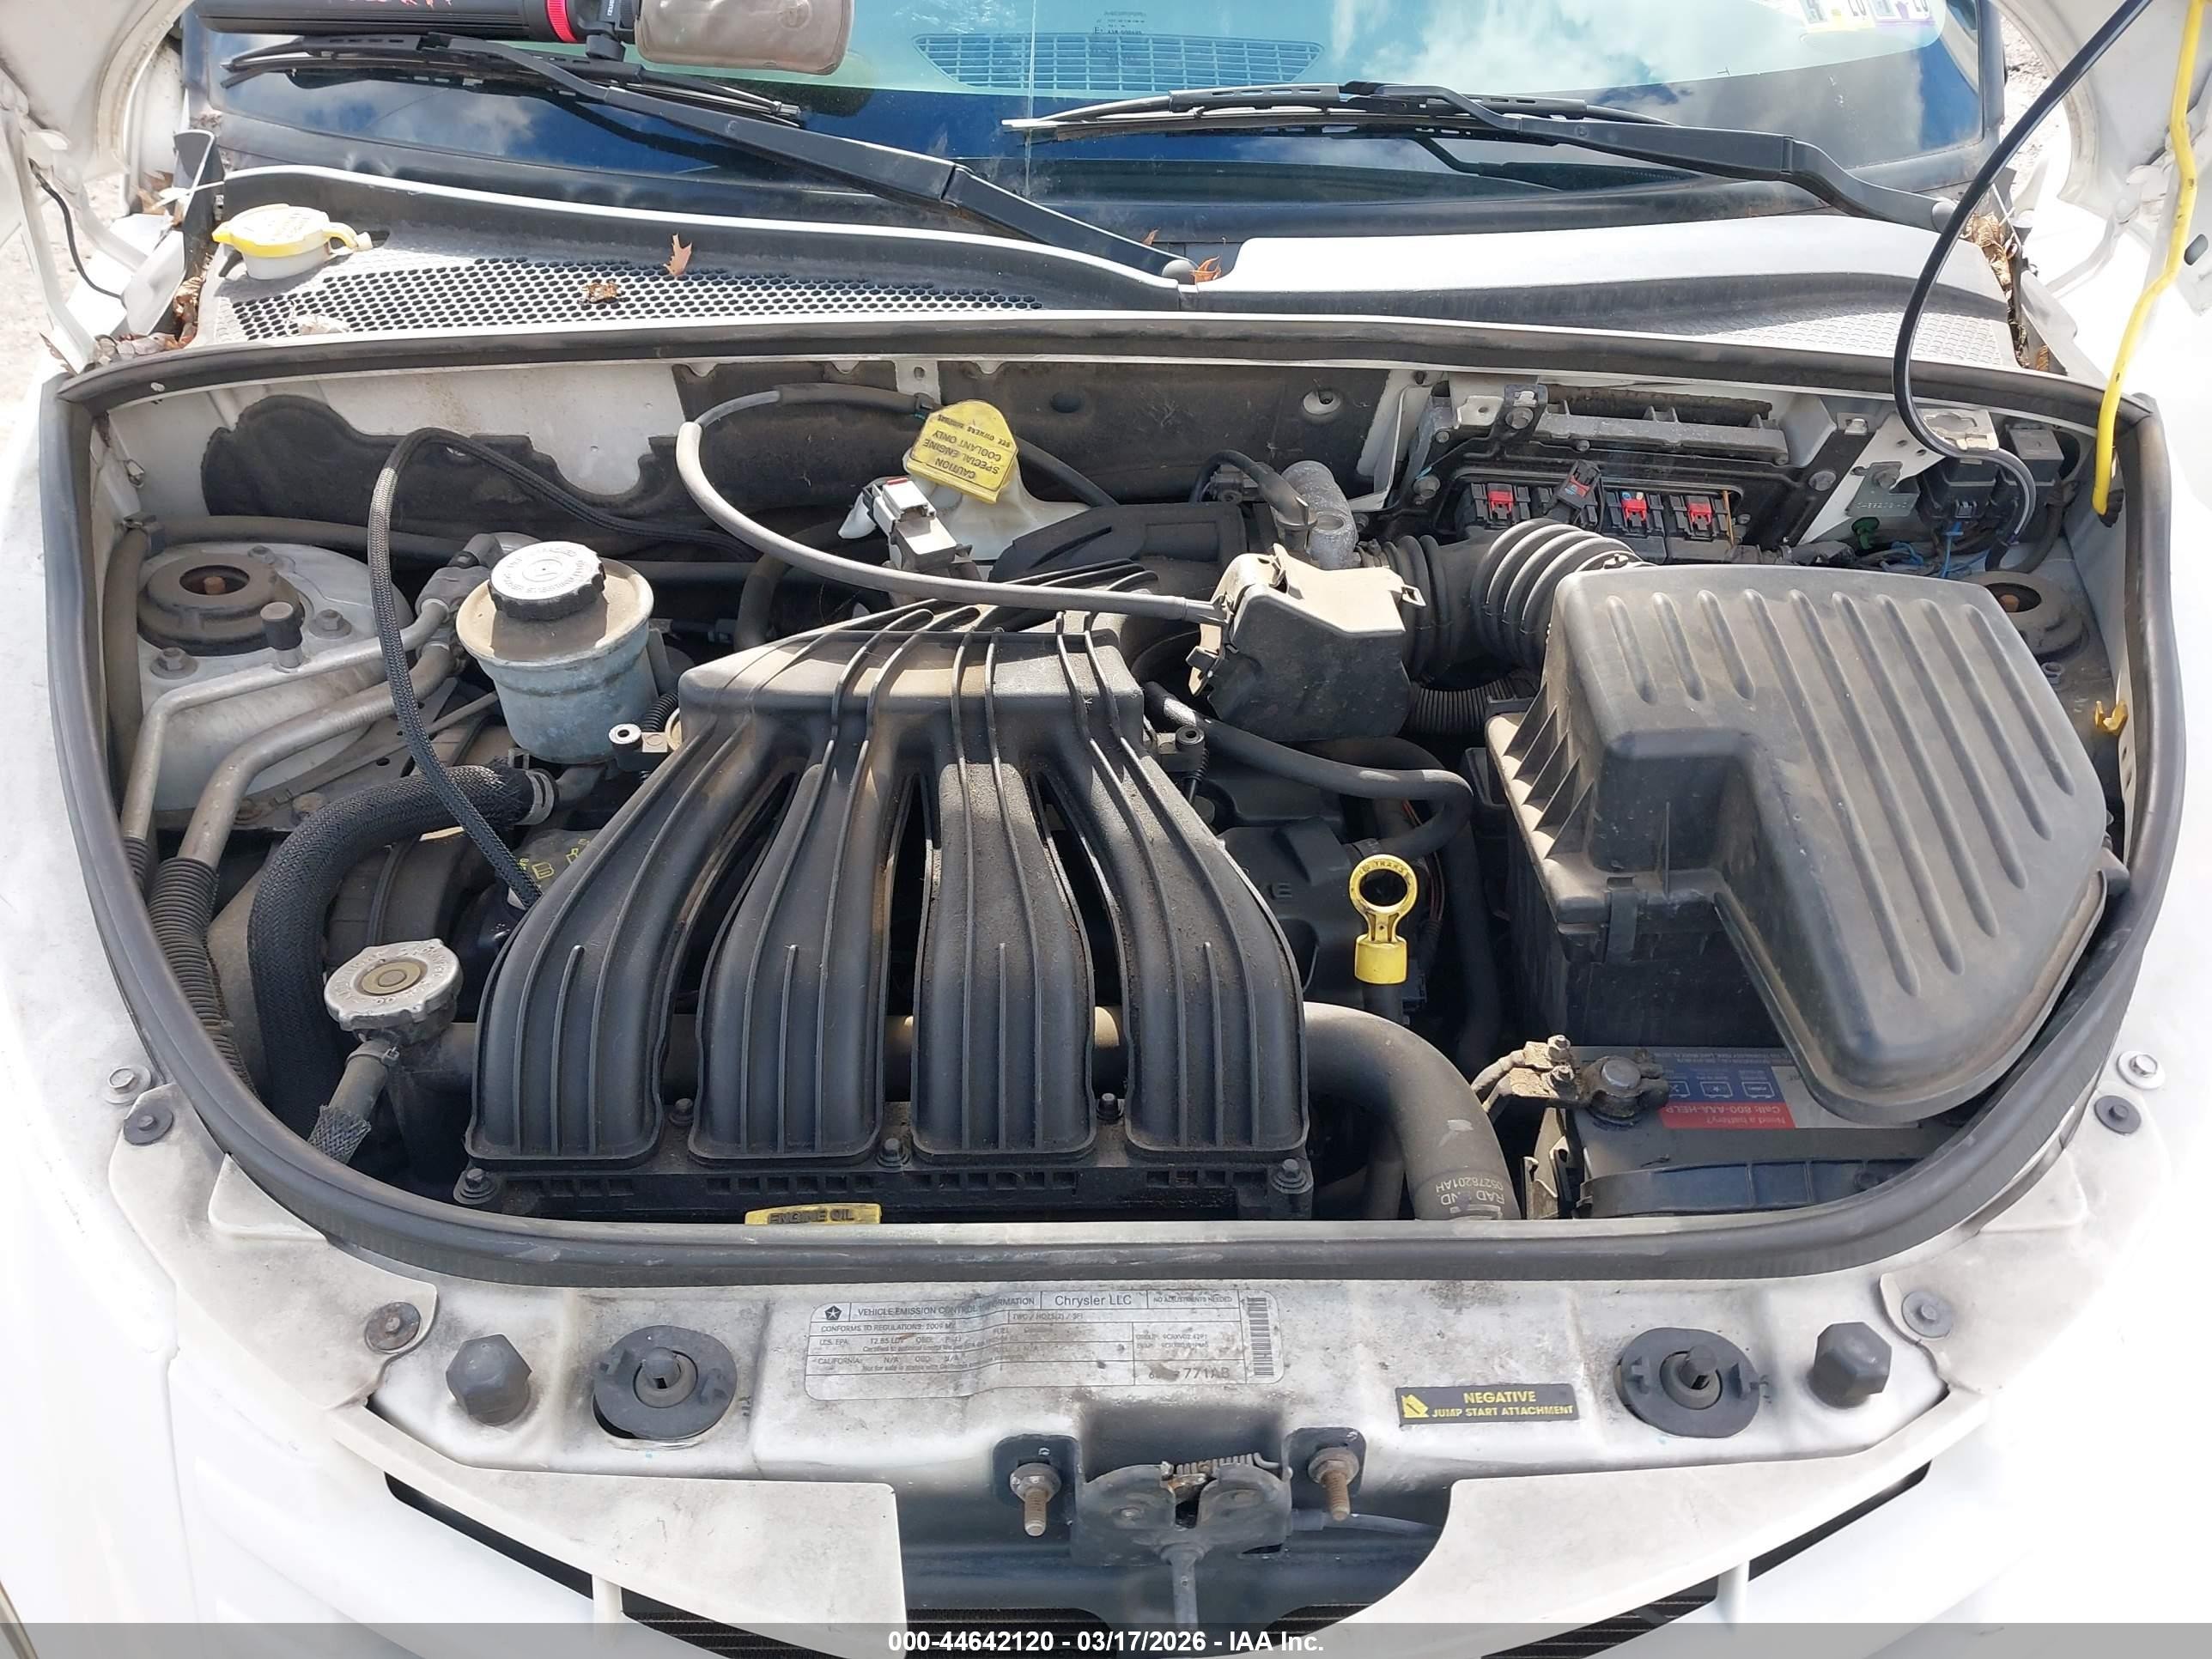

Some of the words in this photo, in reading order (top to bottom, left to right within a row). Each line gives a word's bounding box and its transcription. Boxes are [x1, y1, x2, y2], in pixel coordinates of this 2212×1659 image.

[933, 429, 957, 444] ONLY
[922, 438, 961, 458] ENGINE
[958, 441, 1002, 462] COOLANT
[935, 458, 976, 479] CAUTION
[963, 453, 1000, 475] SPECIAL
[1753, 1105, 1781, 1114] Call:
[1476, 1190, 1505, 1205] RAD
[769, 1209, 827, 1224] ENGINE
[830, 1208, 854, 1221] OIL
[1054, 1295, 1106, 1308] Chrysler
[1109, 1294, 1132, 1306] LLC
[858, 1309, 896, 1317] VEHICLE
[895, 1306, 937, 1316] EMISSION
[939, 1304, 976, 1315] CONTROL
[820, 1324, 862, 1333] CONFORMS
[1463, 1390, 1537, 1404] NEGATIVE
[1431, 1408, 1463, 1418] JUMP
[1465, 1407, 1498, 1417] START
[1502, 1405, 1574, 1416] ATTACHMENT
